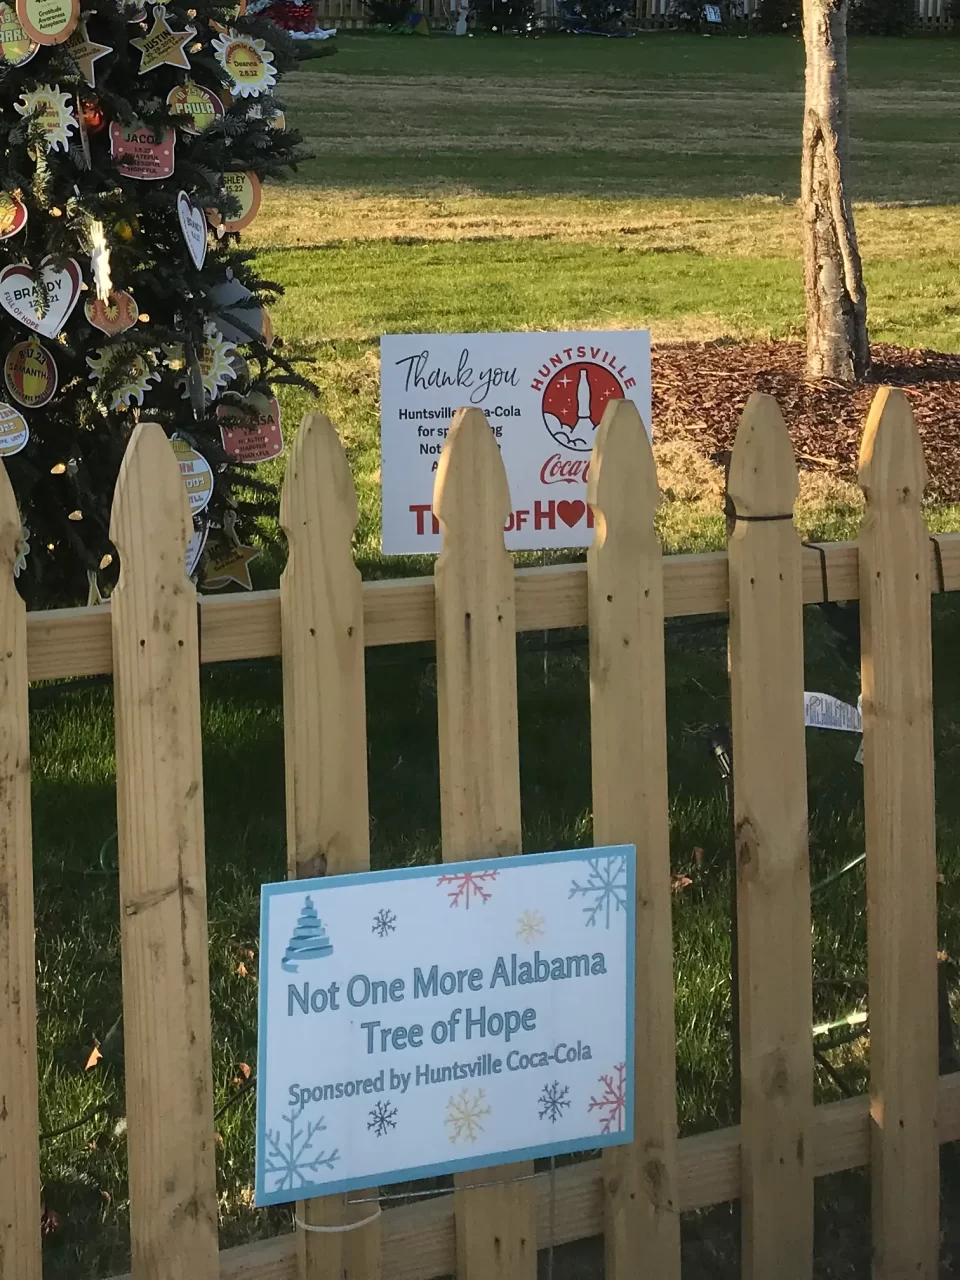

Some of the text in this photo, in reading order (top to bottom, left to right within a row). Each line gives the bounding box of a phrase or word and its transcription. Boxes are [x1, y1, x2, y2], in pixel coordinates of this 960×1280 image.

[143, 29, 171, 52] JUSTIN
[176, 103, 215, 114] PAULA
[13, 279, 62, 301] BRADY
[4, 291, 40, 330] FULL OF HOPE
[395, 348, 520, 404] Thank you
[530, 345, 638, 393] HUNTSVILLE
[484, 405, 521, 418] a-Cola
[418, 425, 435, 437] for
[419, 443, 441, 455] Not
[287, 950, 607, 1017] Not One More Alabama
[361, 1006, 536, 1054] Tree of Hope
[287, 1040, 593, 1110] Sponsored by Huntsville Coca-Cola
